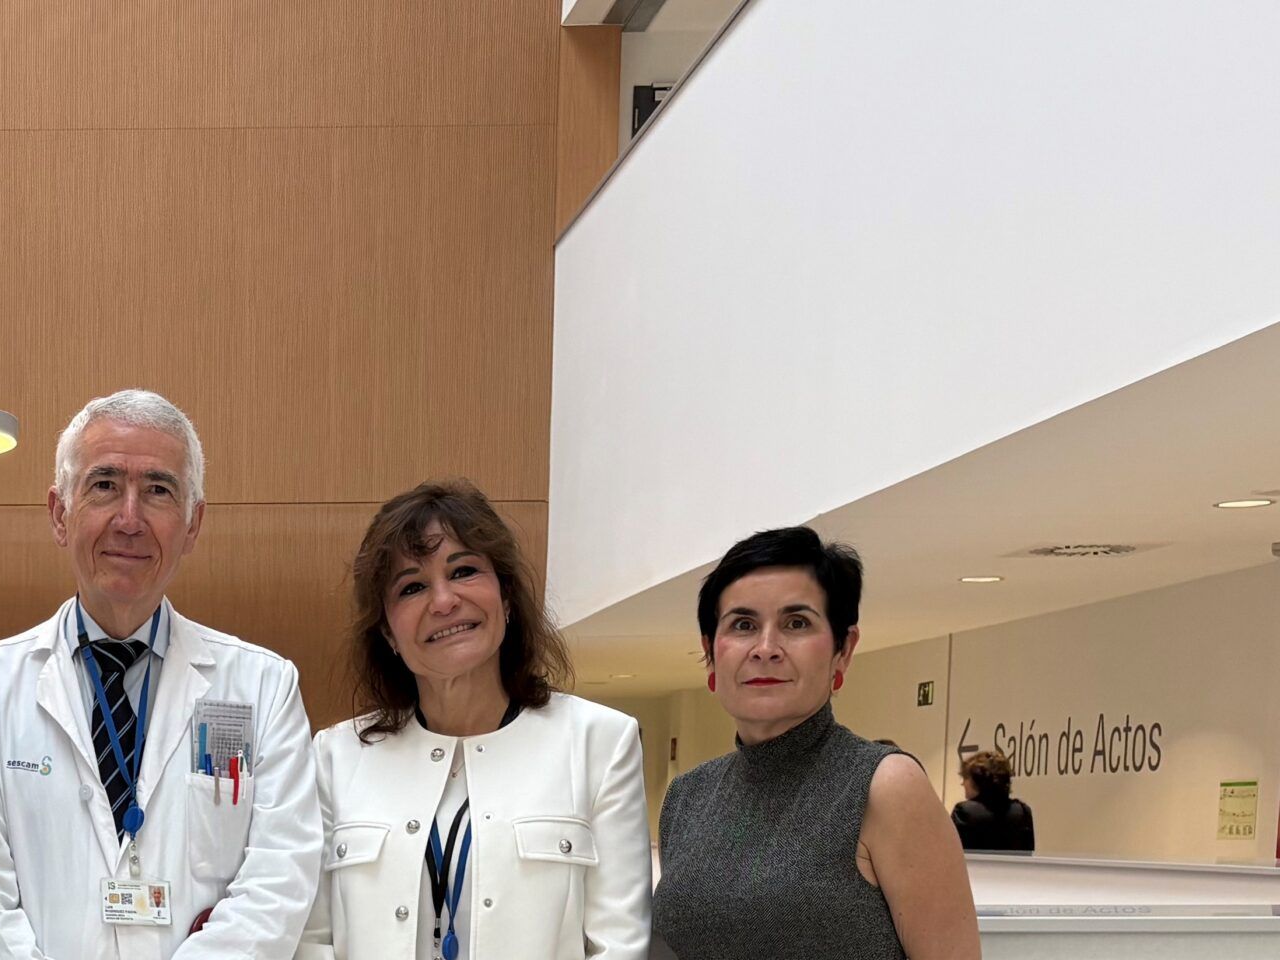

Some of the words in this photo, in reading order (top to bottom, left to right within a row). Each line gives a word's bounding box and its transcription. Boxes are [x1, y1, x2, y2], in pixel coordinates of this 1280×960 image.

[994, 719, 1049, 777] Salón
[1057, 717, 1083, 775] de
[1090, 713, 1162, 773] Actos
[7, 760, 39, 770] sescam
